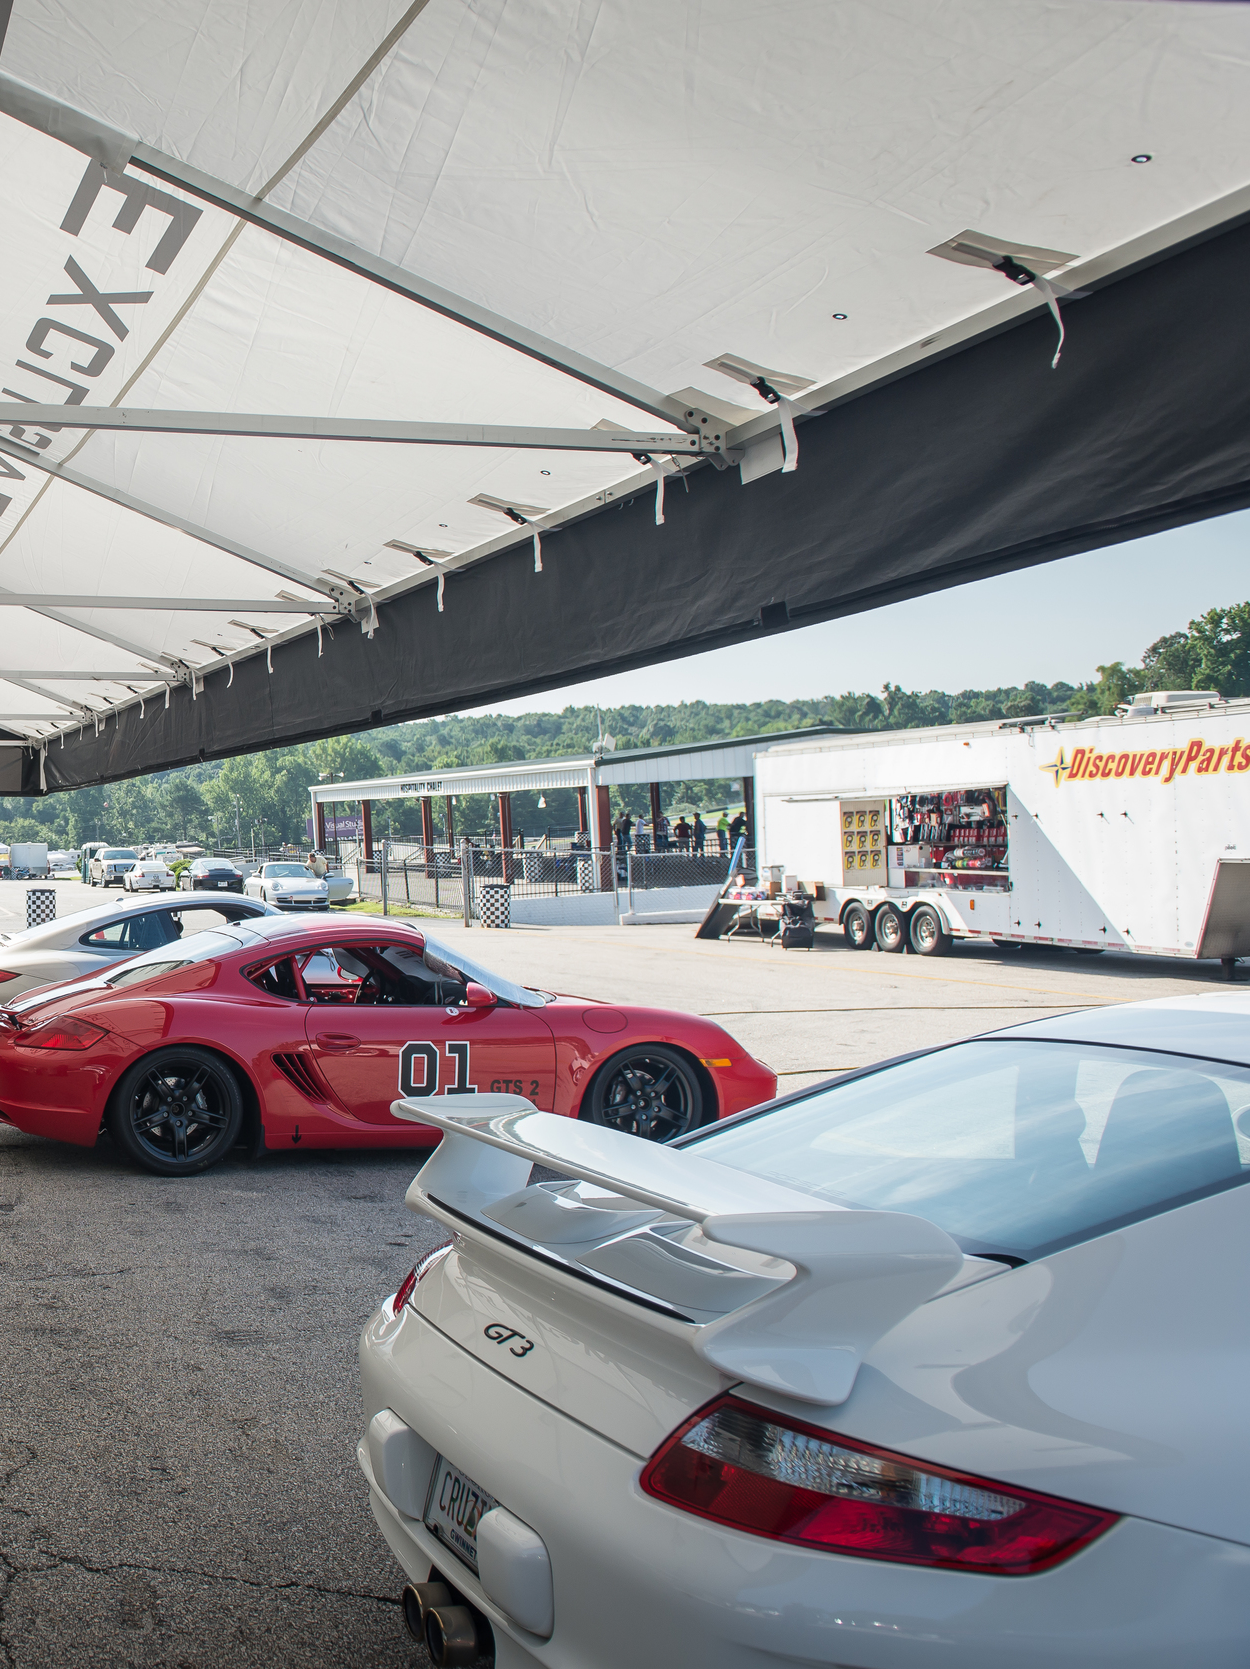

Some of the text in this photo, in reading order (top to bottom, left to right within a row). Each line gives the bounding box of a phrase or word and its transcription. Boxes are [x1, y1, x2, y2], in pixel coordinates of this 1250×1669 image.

[398, 1041, 478, 1098] 01
[490, 1079, 540, 1096] GTS 2
[483, 1322, 535, 1358] GT3
